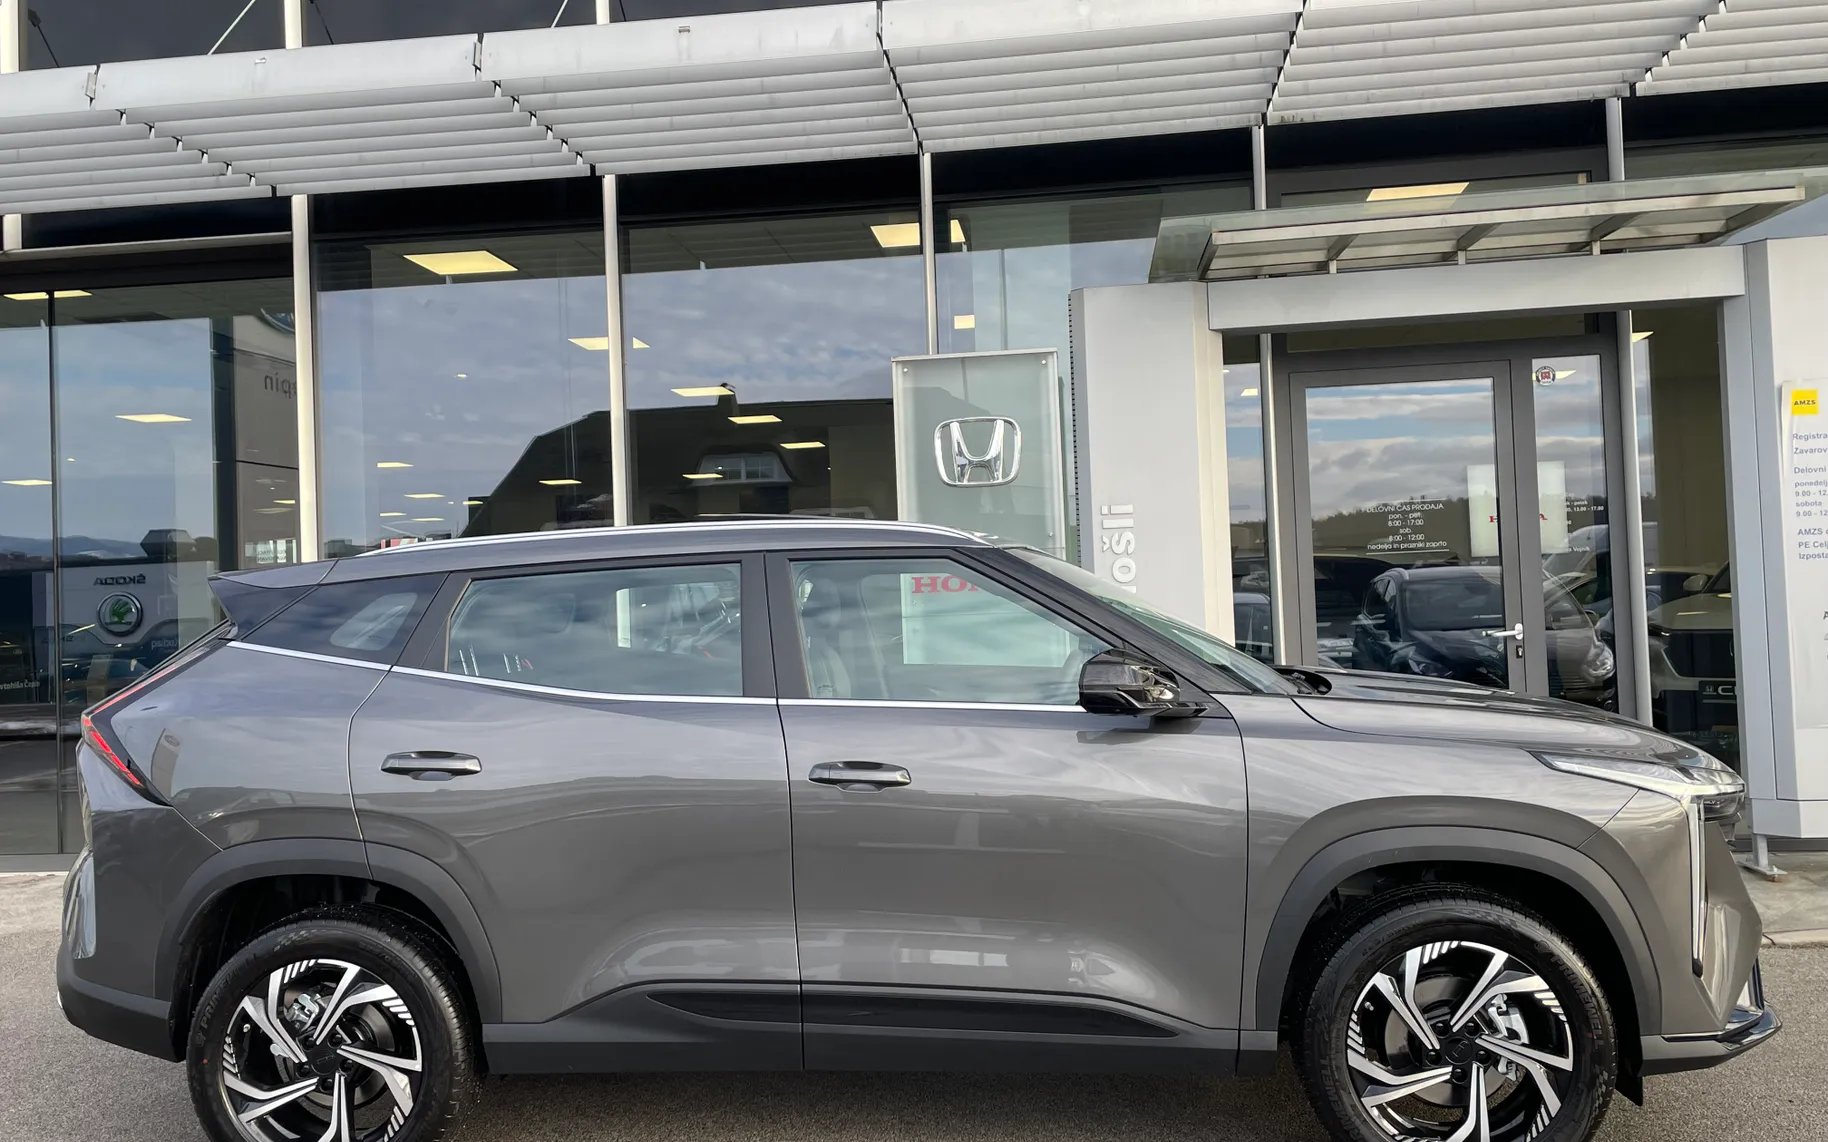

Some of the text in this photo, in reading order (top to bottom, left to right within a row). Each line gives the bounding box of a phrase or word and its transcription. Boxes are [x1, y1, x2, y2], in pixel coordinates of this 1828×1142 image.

[1792, 432, 1828, 441] Registra
[1793, 447, 1828, 455] Zavarov
[1793, 465, 1827, 474] Delovni
[1366, 505, 1395, 513] DELOVNI
[1411, 502, 1444, 511] PRODAJA
[1797, 528, 1823, 536] AMZS
[1101, 504, 1137, 595] ošli
[1400, 541, 1425, 550] prazniki
[1425, 540, 1448, 548] zaprto
[1798, 541, 1811, 549] PE
